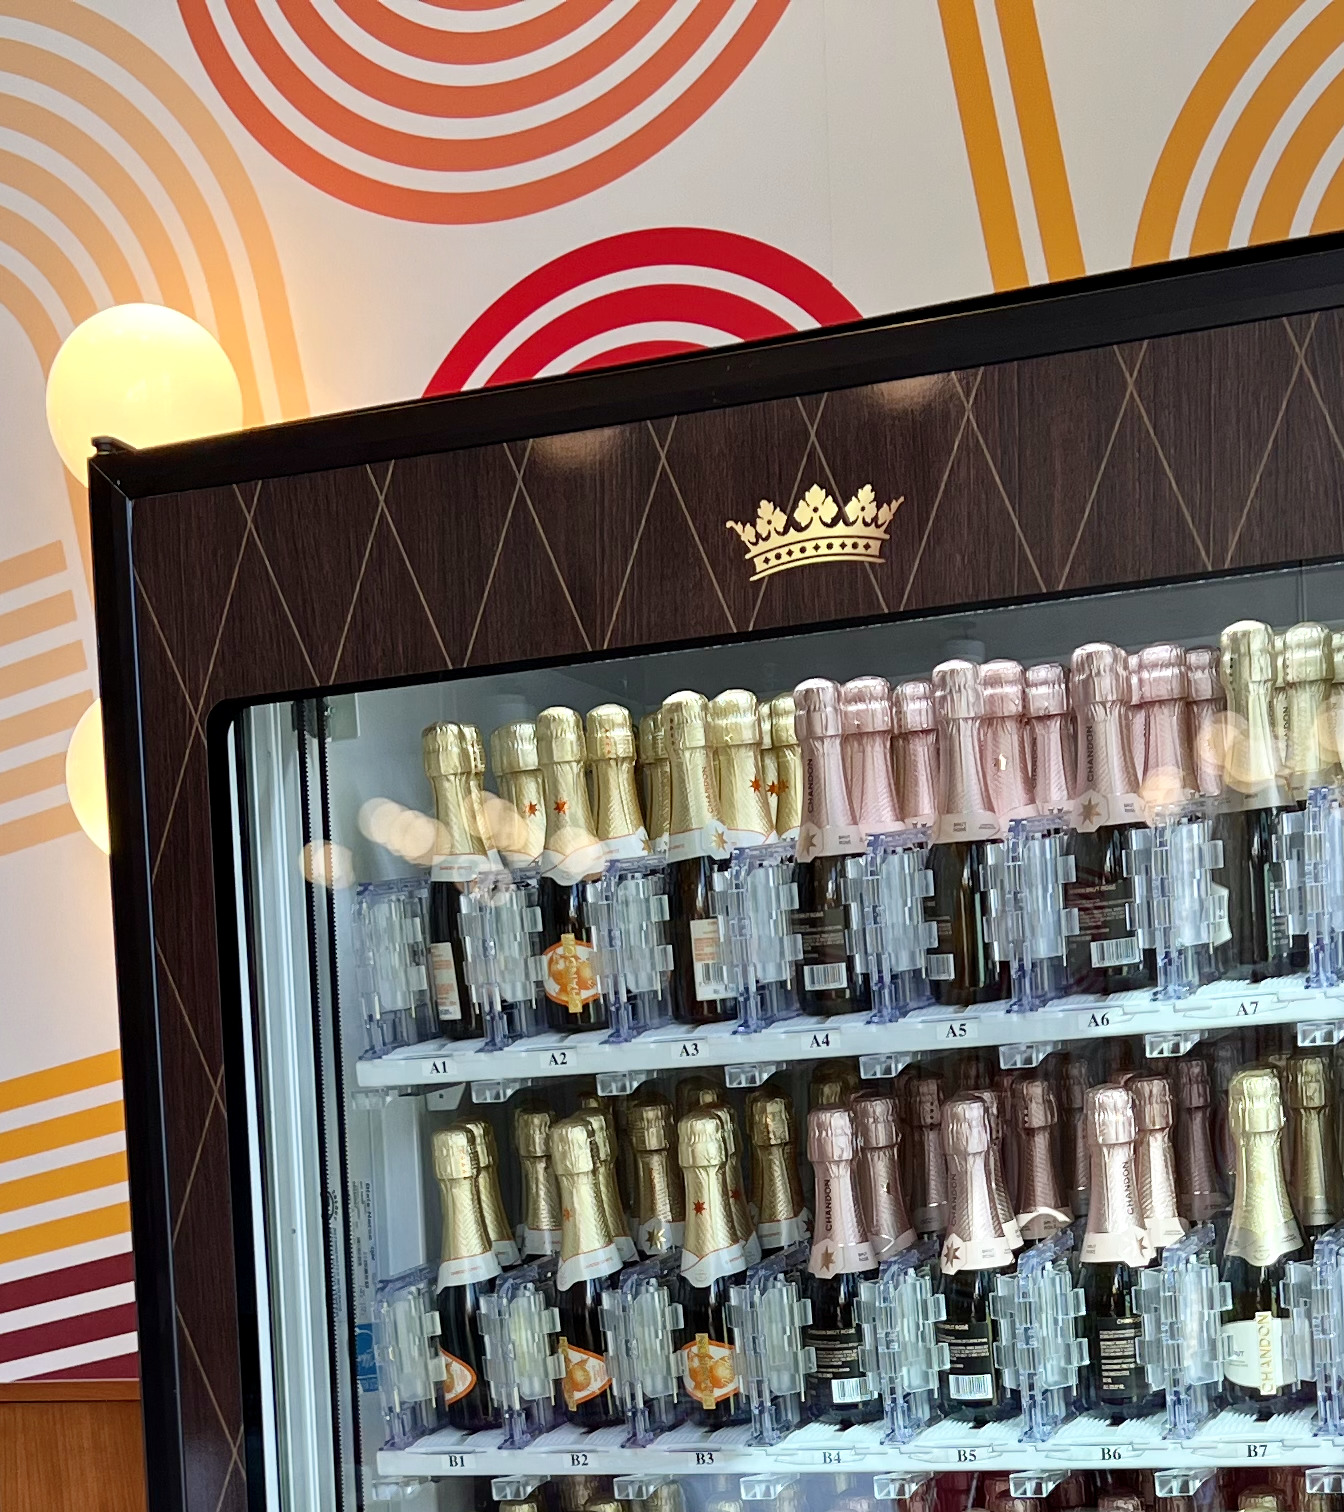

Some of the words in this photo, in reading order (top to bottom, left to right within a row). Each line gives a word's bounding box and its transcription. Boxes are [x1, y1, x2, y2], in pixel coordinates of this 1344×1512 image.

[1086, 725, 1095, 783] CHANDON
[806, 758, 814, 814] CHANDON
[1235, 1000, 1259, 1017] A7
[1087, 1012, 1110, 1028] A6
[945, 1023, 968, 1039] A5
[809, 1033, 831, 1048] A4
[679, 1042, 700, 1058] A3
[548, 1051, 568, 1067] A2
[429, 1060, 449, 1075] A1
[1122, 1160, 1134, 1216] CHANDON
[824, 1178, 833, 1232] CHANDON
[1257, 1313, 1274, 1393] CHANDON
[695, 1452, 715, 1465] B3
[822, 1450, 842, 1465] B4
[956, 1448, 977, 1463] B5
[1100, 1446, 1122, 1461] B6
[1246, 1443, 1268, 1458] B7
[449, 1454, 465, 1468] B1
[570, 1453, 589, 1467] B2
